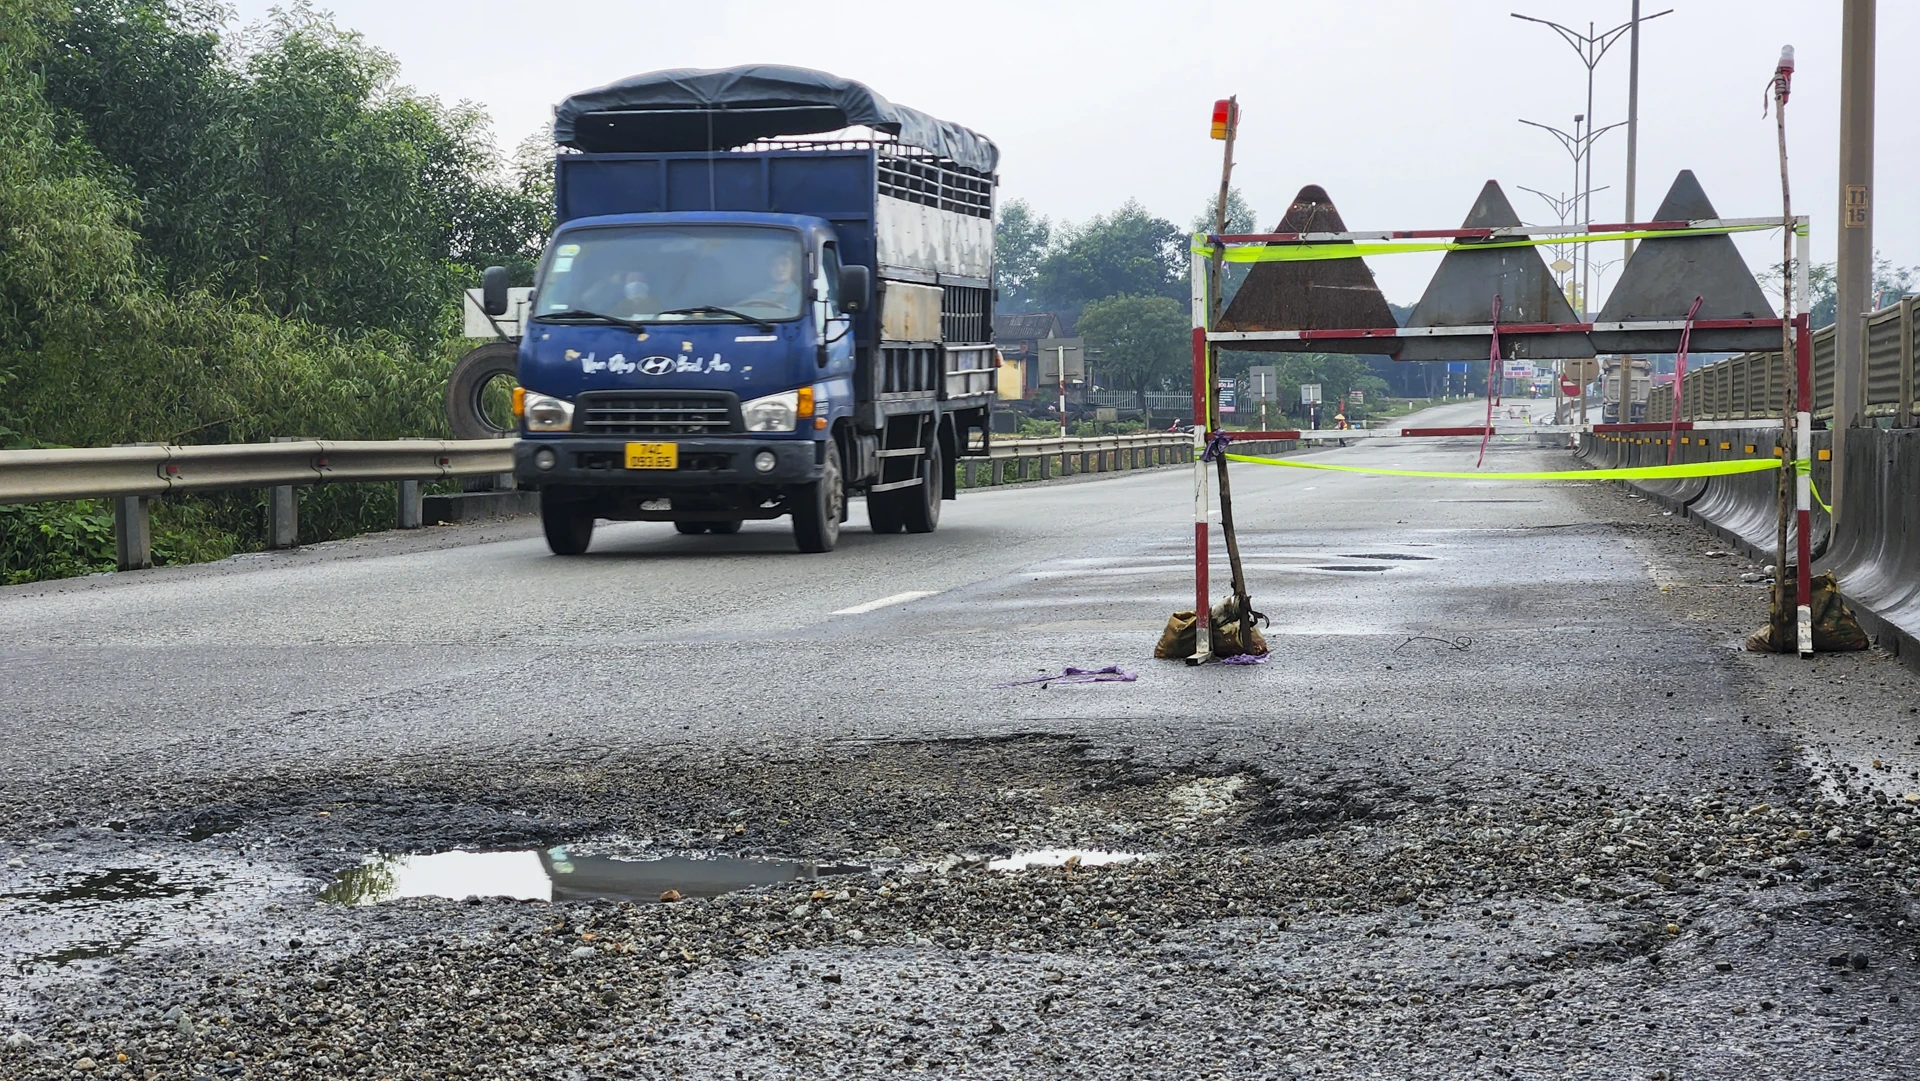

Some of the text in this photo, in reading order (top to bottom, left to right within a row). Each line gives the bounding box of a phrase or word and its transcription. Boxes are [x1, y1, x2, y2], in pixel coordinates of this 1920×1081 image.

[1850, 190, 1865, 204] T1
[1849, 208, 1865, 222] 15
[640, 443, 662, 455] 74C
